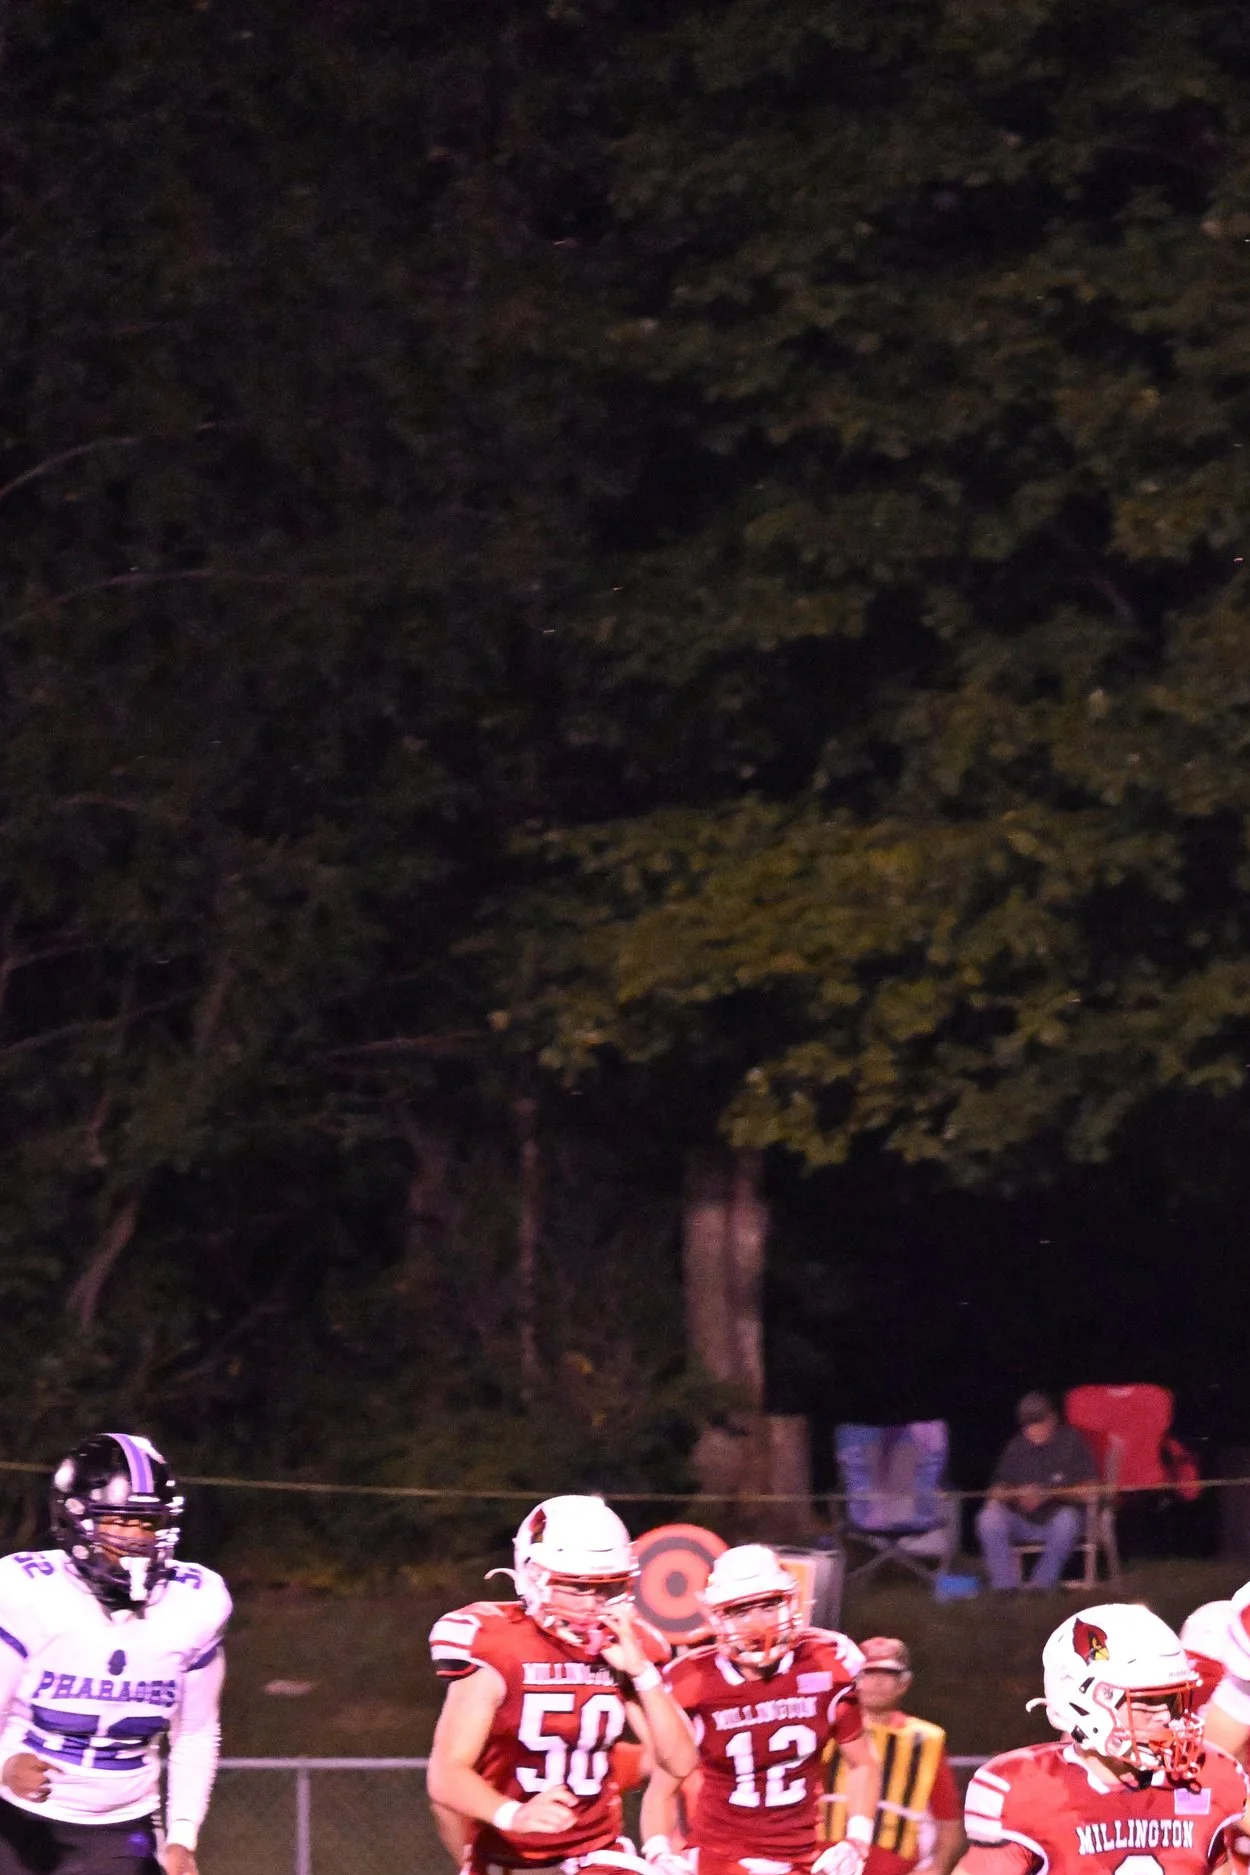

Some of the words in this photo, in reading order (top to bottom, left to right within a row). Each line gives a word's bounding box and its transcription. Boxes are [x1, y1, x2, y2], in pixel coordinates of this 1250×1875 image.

[516, 1692, 626, 1796] 50
[725, 1724, 817, 1808] 12
[1075, 1818, 1195, 1856] MILLINGTON
